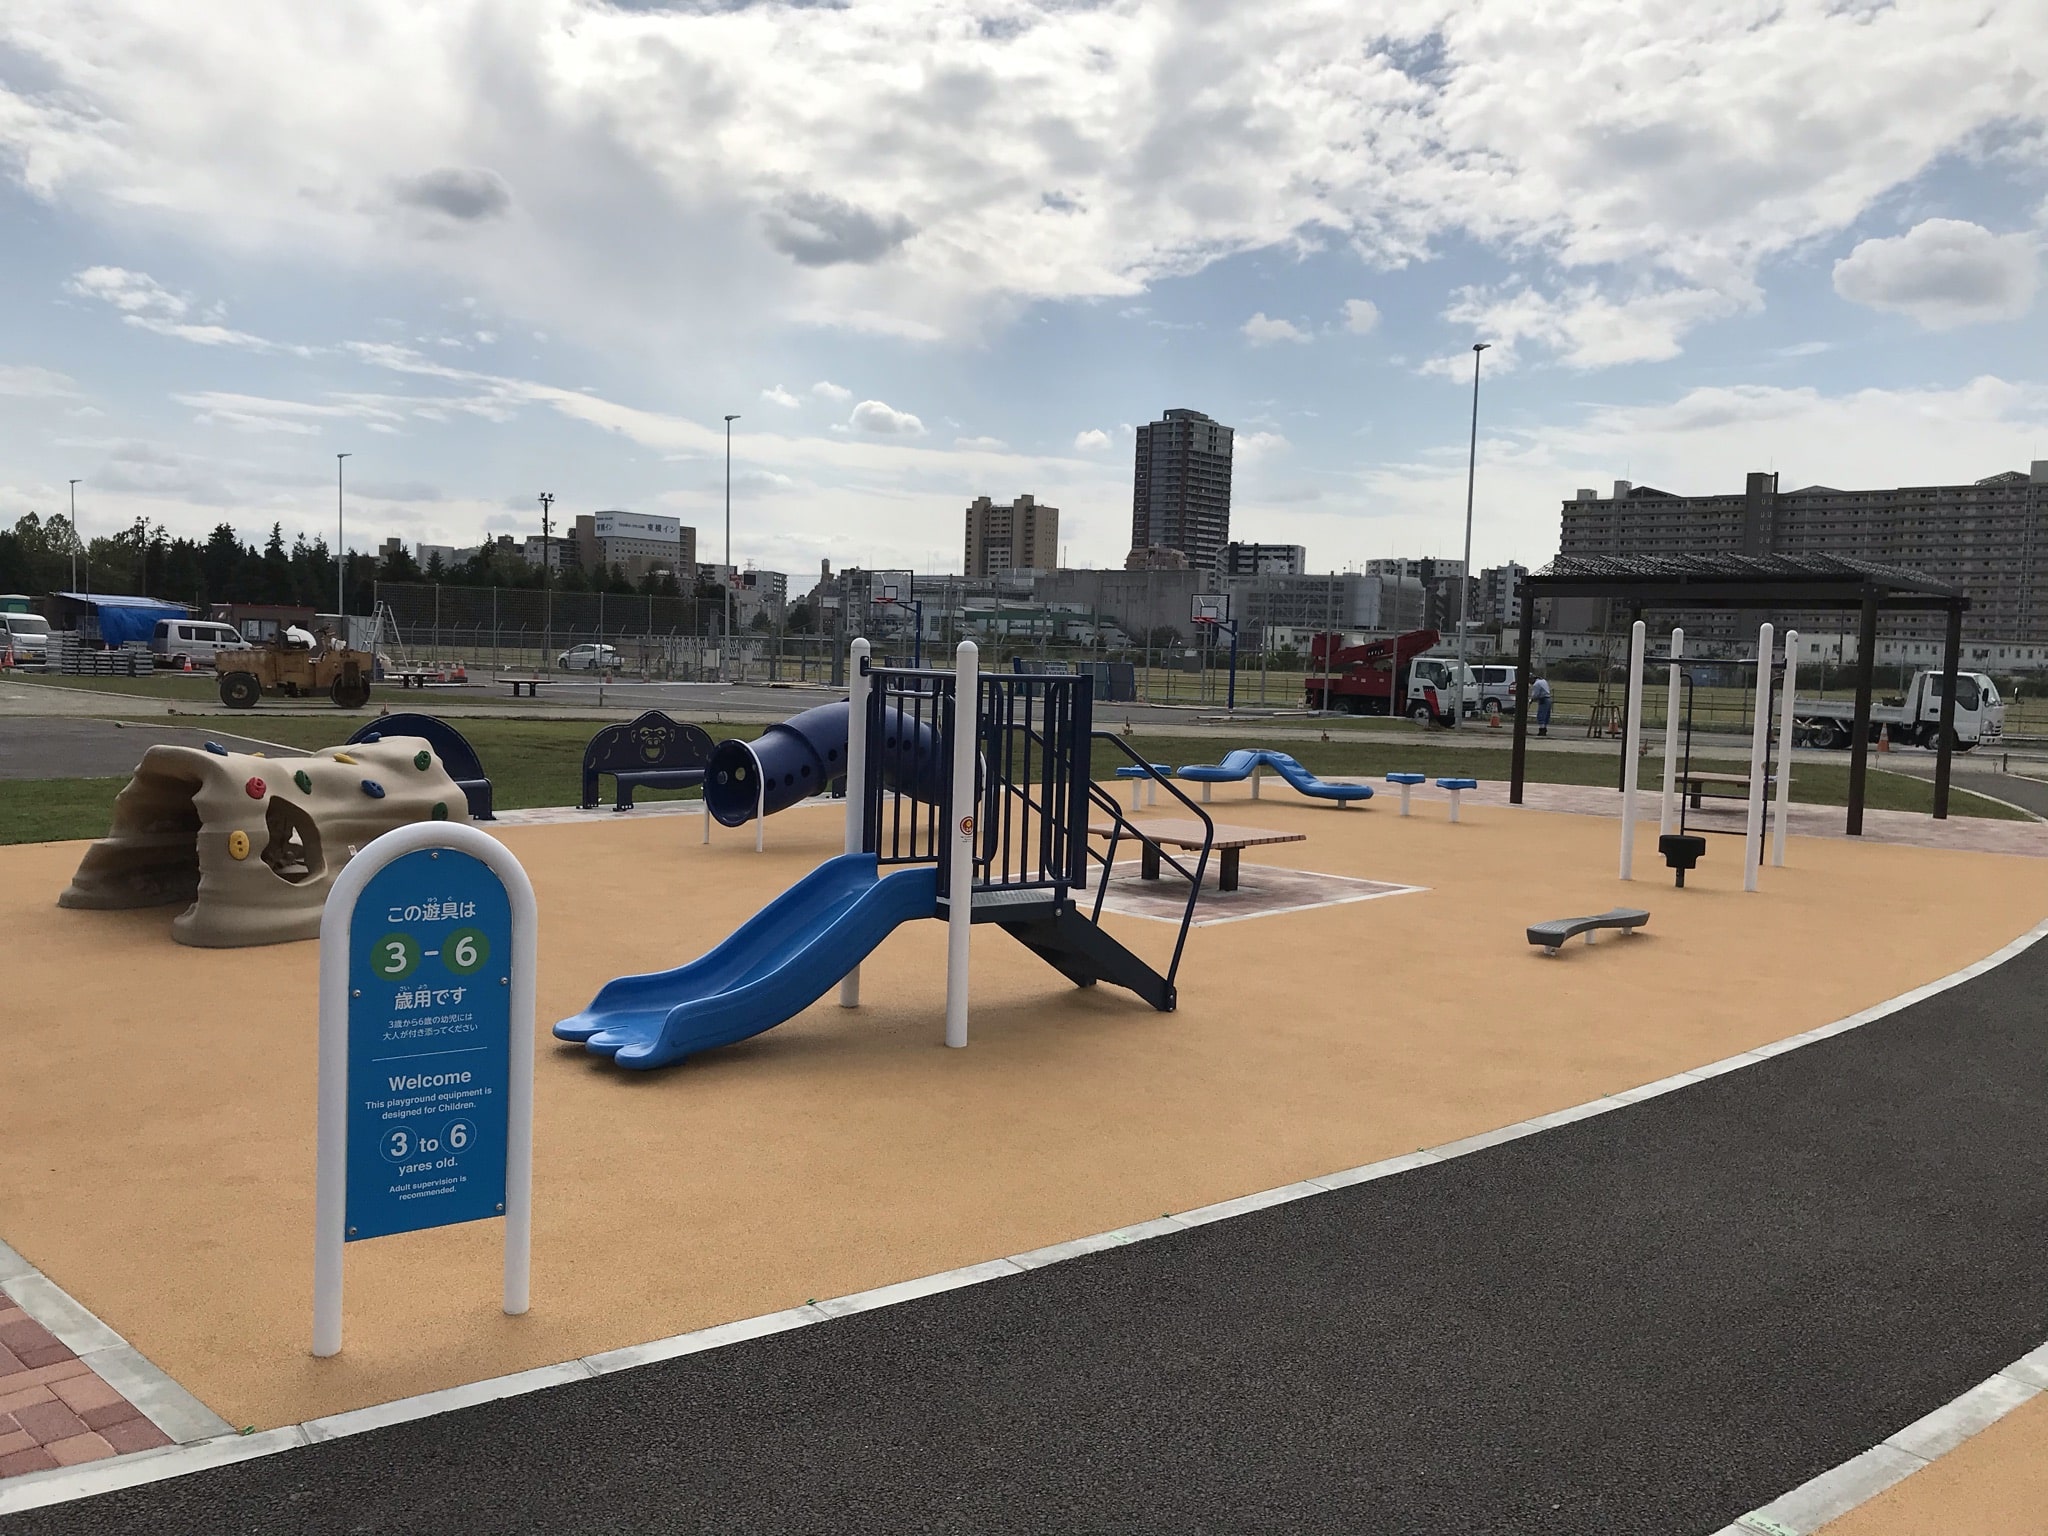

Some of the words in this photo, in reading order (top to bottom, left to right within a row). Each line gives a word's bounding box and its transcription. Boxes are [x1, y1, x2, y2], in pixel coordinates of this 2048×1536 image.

[387, 901, 476, 923] この遊具は
[384, 942, 407, 973] 3
[455, 936, 477, 967] 6
[394, 986, 467, 1011] 歳用です
[388, 1012, 473, 1029] 3歳から6歳の幼児には
[382, 1023, 479, 1041] 大人が付き添ってください
[388, 1070, 472, 1092] Welcome
[365, 1100, 385, 1110] This
[387, 1093, 436, 1109] playground
[438, 1087, 483, 1102] equipment
[484, 1086, 492, 1095] is
[381, 1107, 422, 1120] designed
[424, 1105, 437, 1115] for
[438, 1101, 477, 1113] Children.
[390, 1132, 408, 1157] 3
[419, 1137, 439, 1153] to
[450, 1123, 467, 1148] 6
[398, 1162, 433, 1177] yares
[435, 1156, 459, 1170] old.
[389, 1183, 411, 1193] Adult
[412, 1176, 458, 1190] supervision
[459, 1175, 467, 1183] is
[399, 1186, 457, 1201] recommended.
